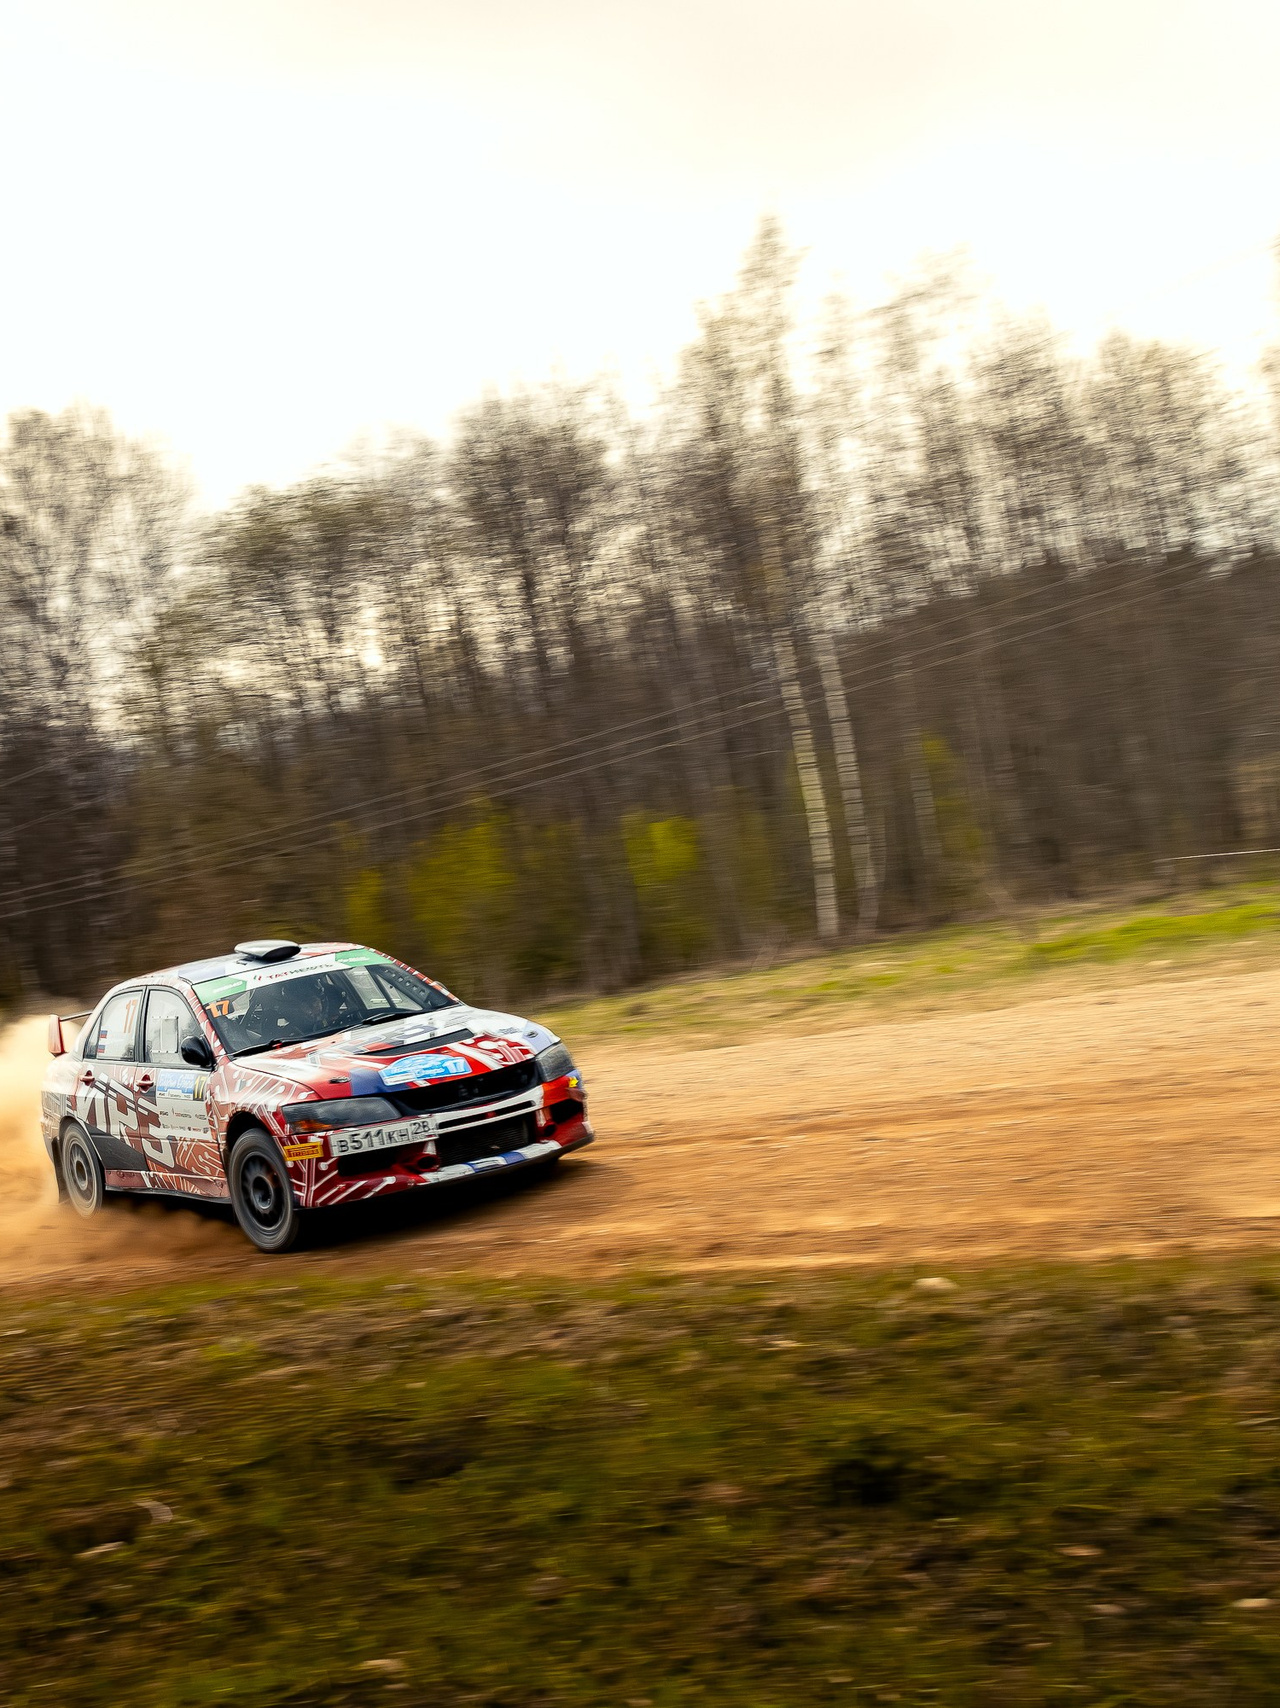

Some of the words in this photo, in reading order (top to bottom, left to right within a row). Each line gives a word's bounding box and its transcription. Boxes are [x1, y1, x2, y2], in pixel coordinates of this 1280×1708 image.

[123, 999, 139, 1034] 17
[205, 1000, 230, 1018] 17
[442, 1059, 466, 1074] 17
[194, 1074, 208, 1099] 17
